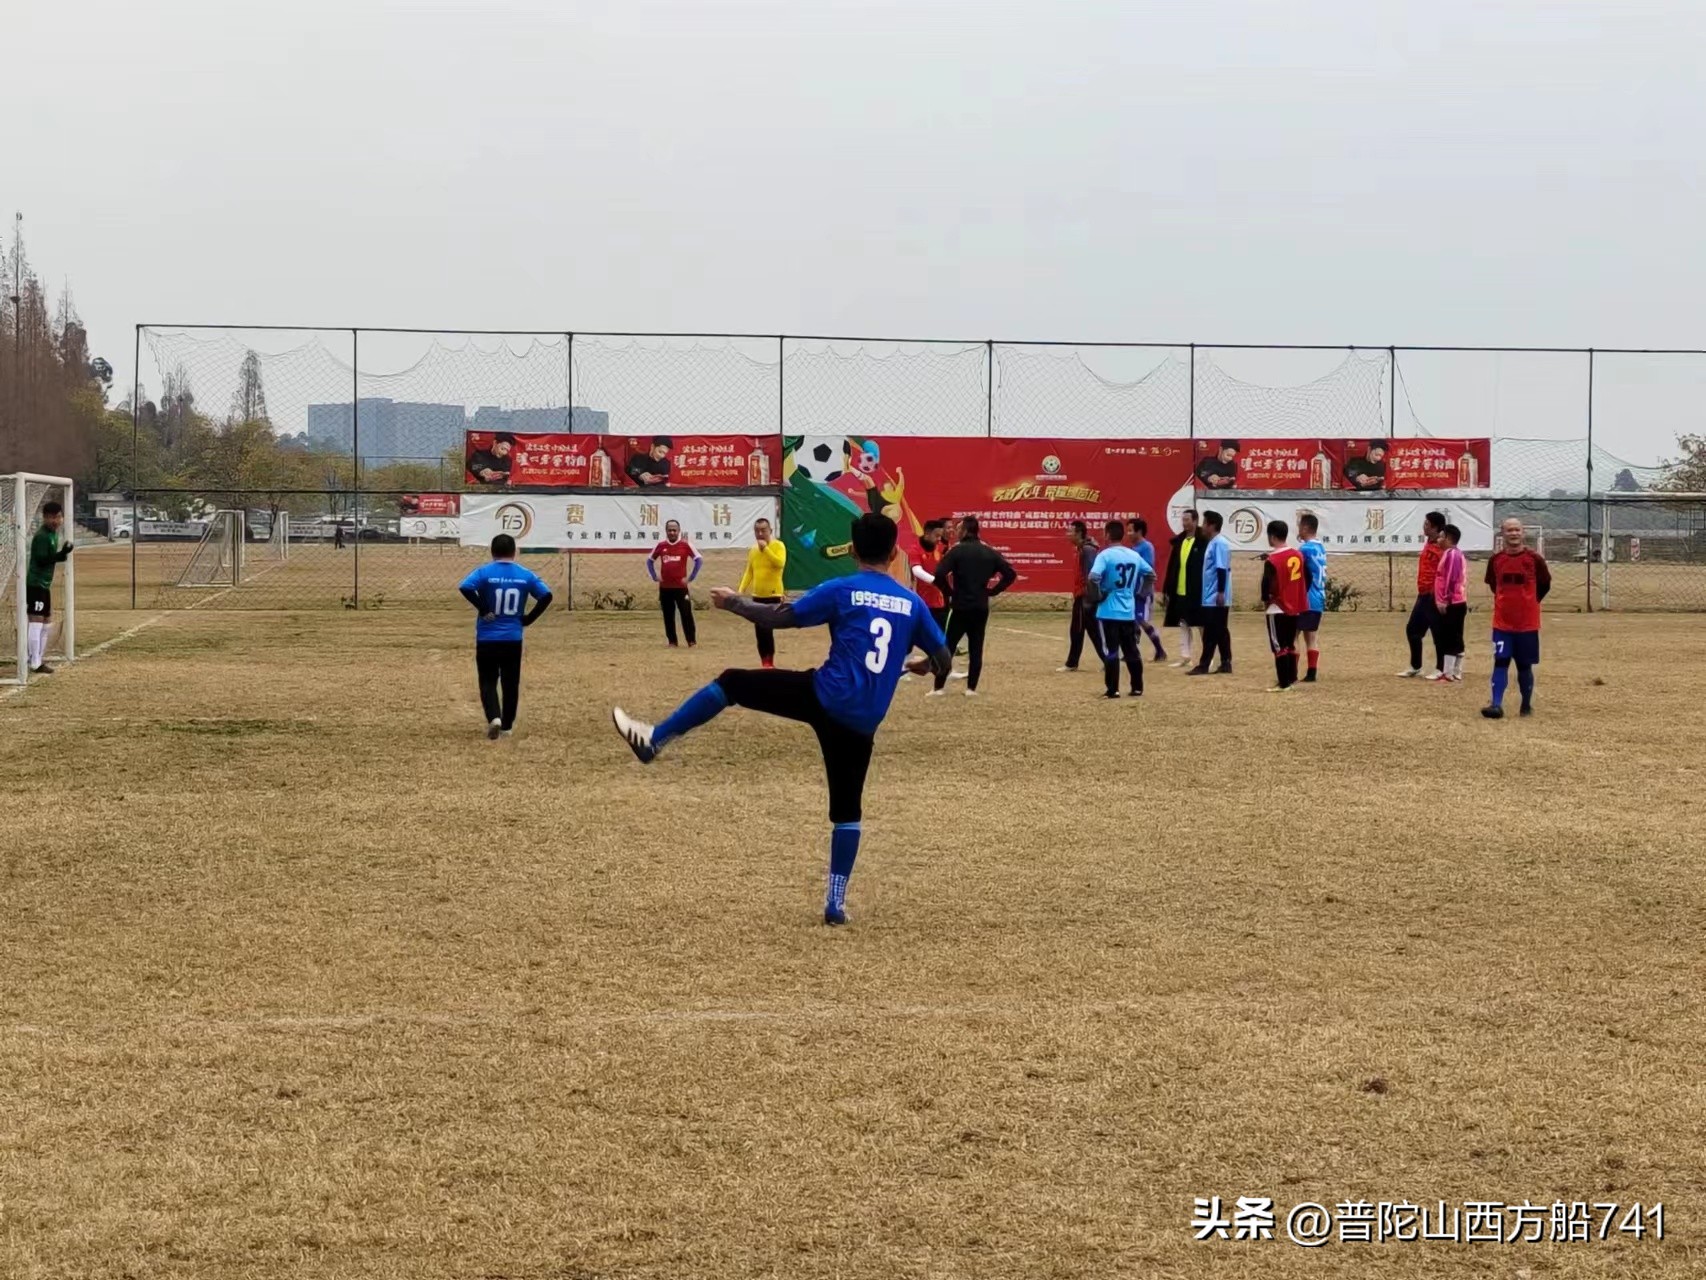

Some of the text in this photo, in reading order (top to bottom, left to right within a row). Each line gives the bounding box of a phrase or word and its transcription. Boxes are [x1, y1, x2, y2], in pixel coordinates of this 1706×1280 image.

[1115, 563, 1136, 589] 37
[1287, 556, 1301, 581] 2
[34, 601, 44, 612] 19
[495, 588, 520, 615] 10
[865, 617, 892, 674] 3
